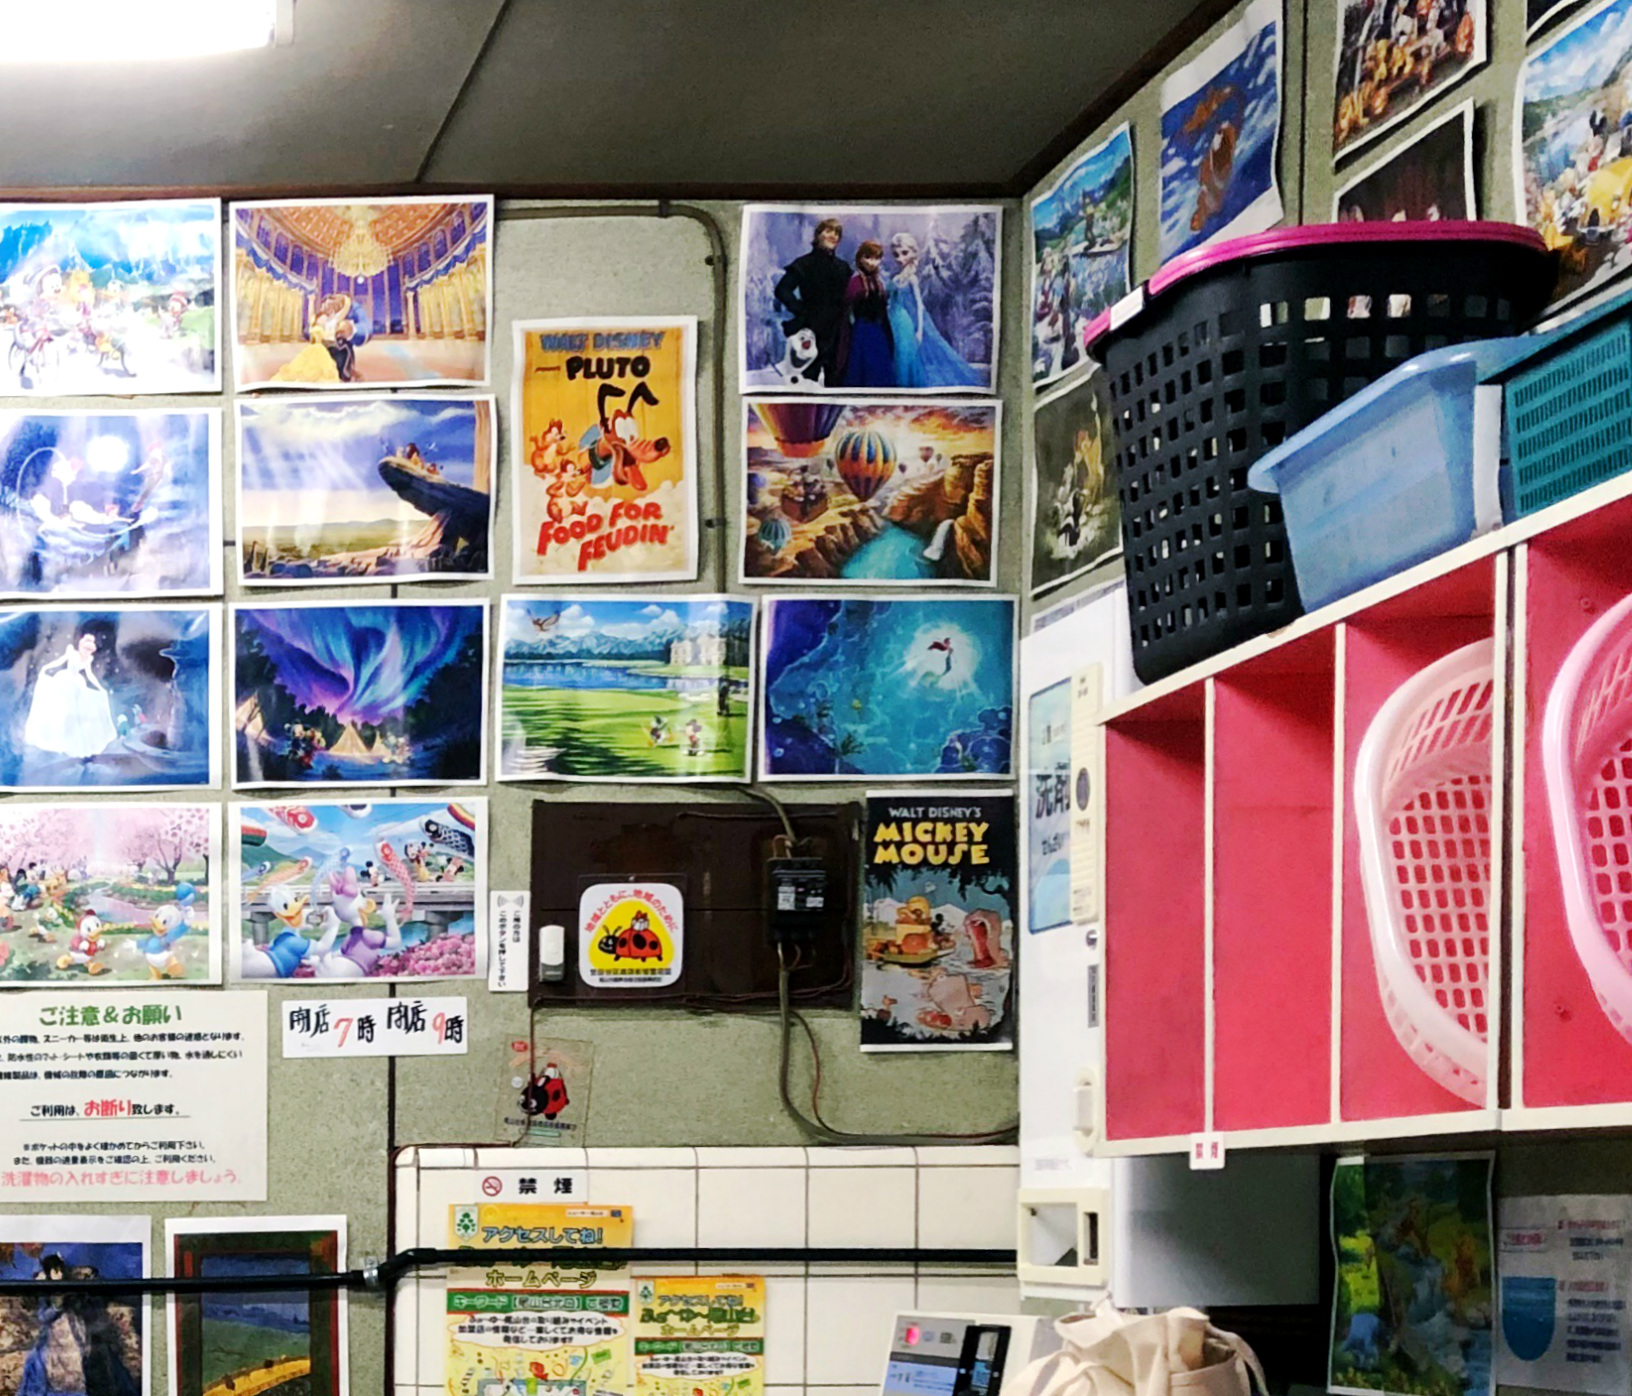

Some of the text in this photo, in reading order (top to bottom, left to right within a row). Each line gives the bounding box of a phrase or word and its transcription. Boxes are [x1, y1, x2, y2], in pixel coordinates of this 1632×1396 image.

[540, 332, 665, 351] WALT DISNEY
[565, 356, 651, 381] PLUTO
[536, 502, 663, 556] FOOD FOR
[577, 524, 675, 572] FEUDIN'
[888, 806, 982, 819] WALT DISNEY'S
[873, 821, 990, 843] MICKEY
[873, 843, 990, 865] MOUSE
[518, 1177, 574, 1195] 禁煙
[486, 1269, 597, 1289] ホームページ
